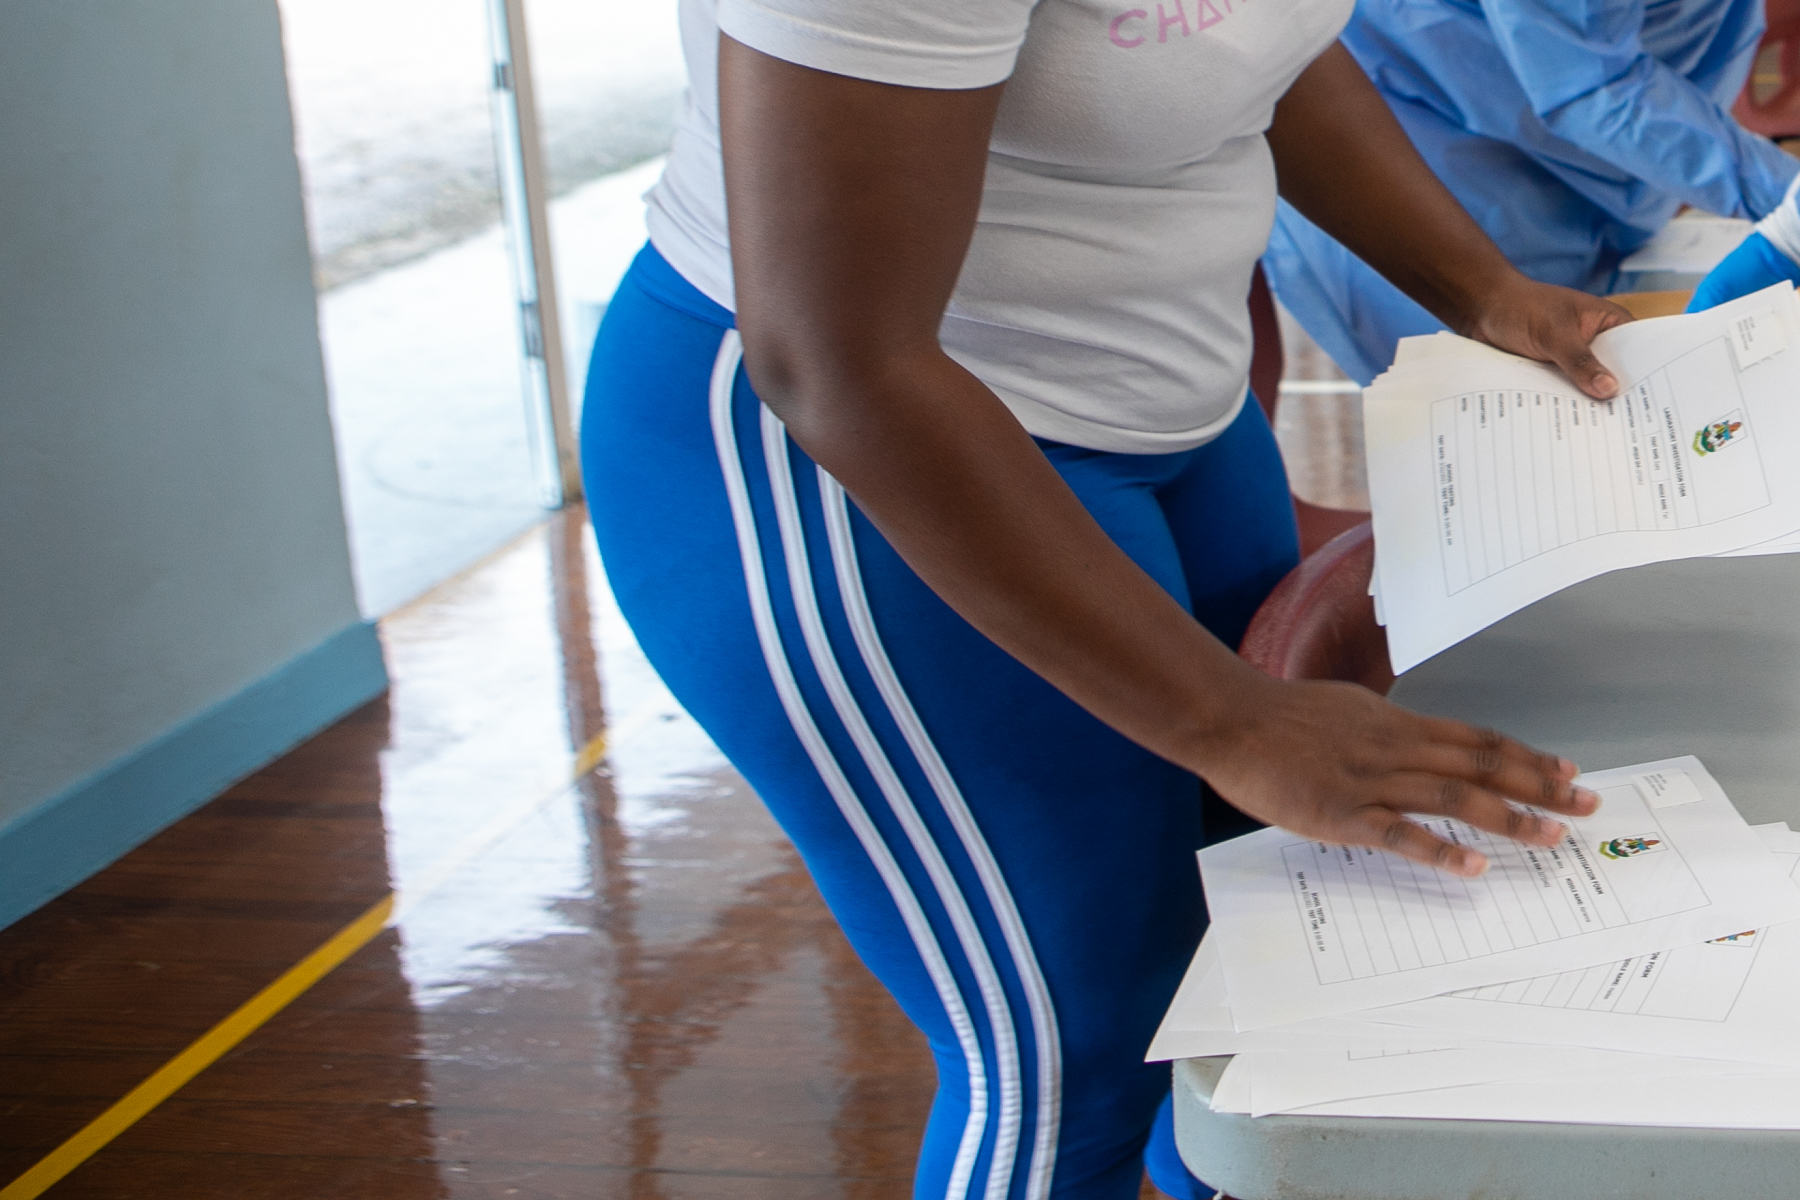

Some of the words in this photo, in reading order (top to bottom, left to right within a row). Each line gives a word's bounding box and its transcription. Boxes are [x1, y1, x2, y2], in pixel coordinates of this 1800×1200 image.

[1571, 846, 1597, 881] INVESTIGATION
[1590, 879, 1605, 895] FORM
[1641, 961, 1655, 979] FORM
